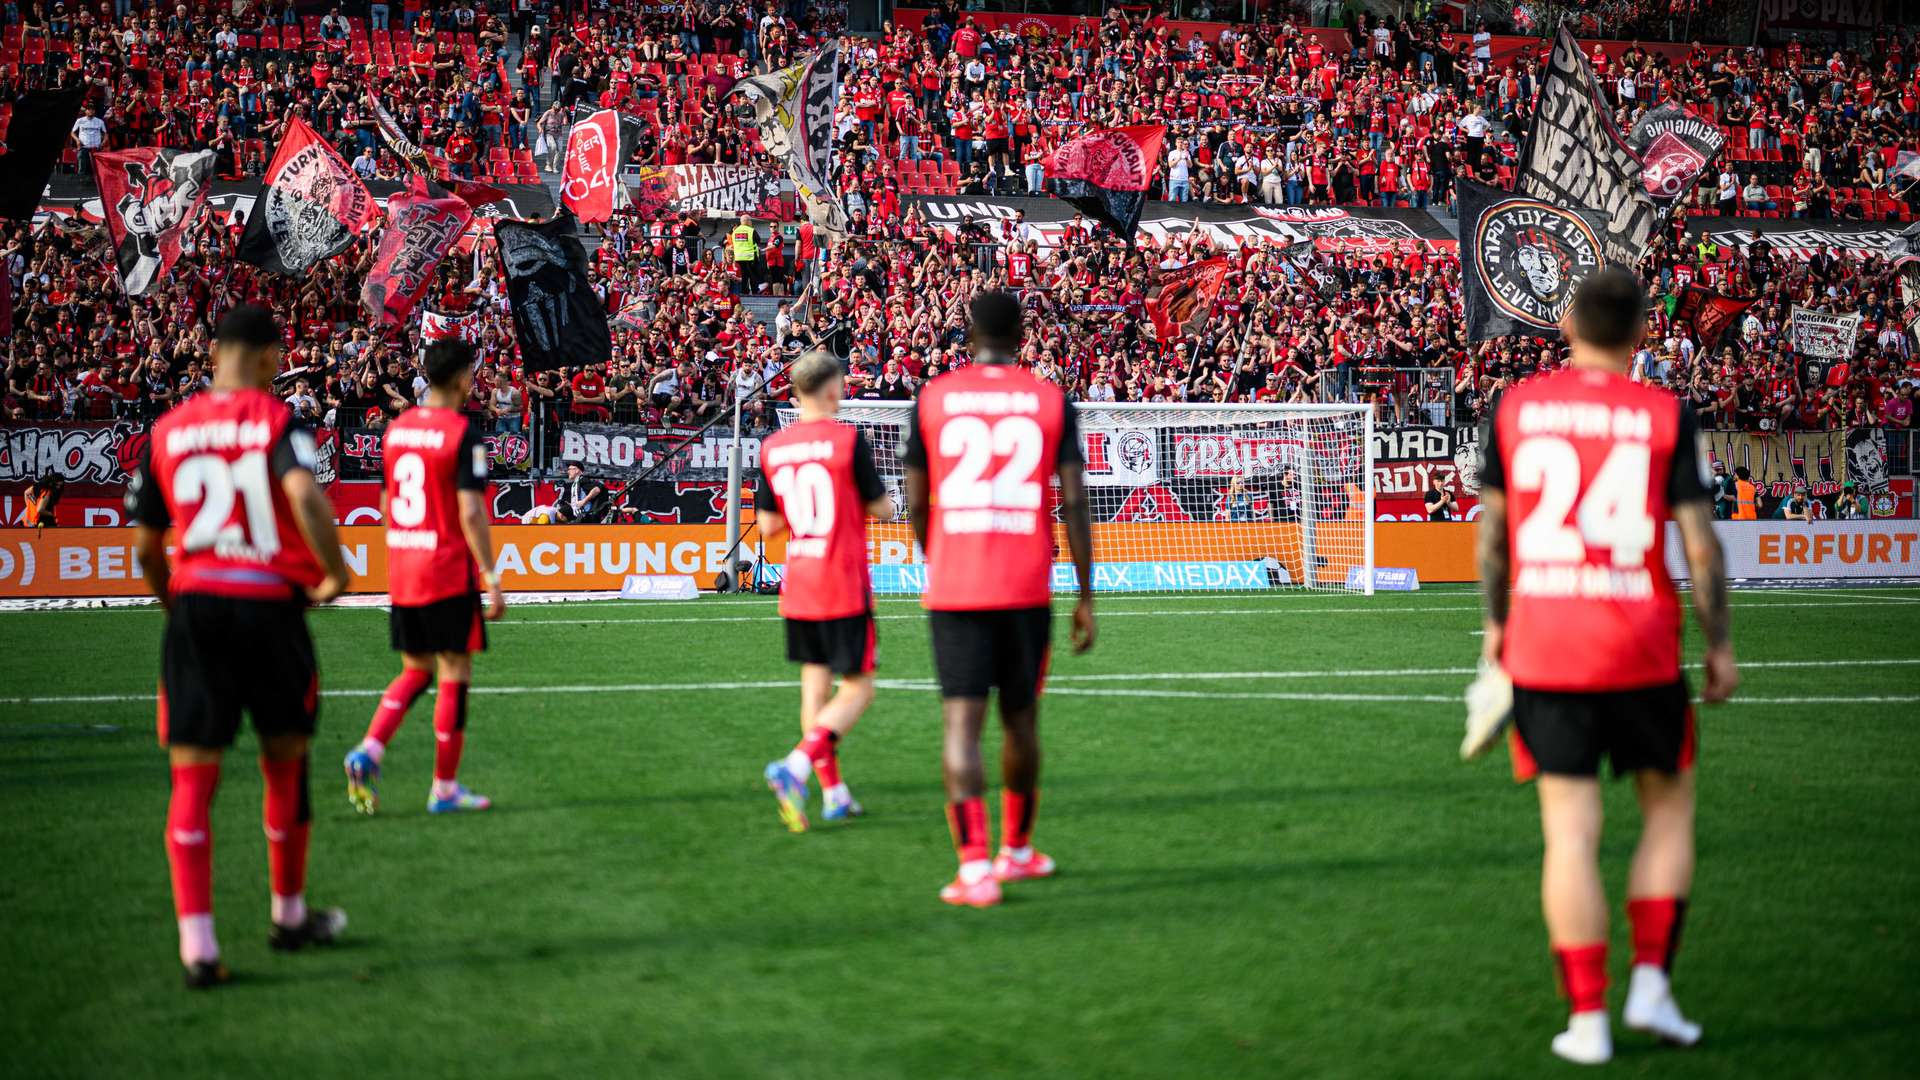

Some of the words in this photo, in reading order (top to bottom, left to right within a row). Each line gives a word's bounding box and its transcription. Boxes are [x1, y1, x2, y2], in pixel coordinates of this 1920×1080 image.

[938, 415, 1044, 510] 22
[1373, 429, 1450, 459] MAD
[173, 450, 282, 554] 21
[390, 452, 427, 528] 3
[770, 461, 836, 539] 10
[1511, 434, 1656, 567] 24
[1154, 563, 1264, 587] NIEDAX
[1758, 533, 1918, 565] ERFURT
